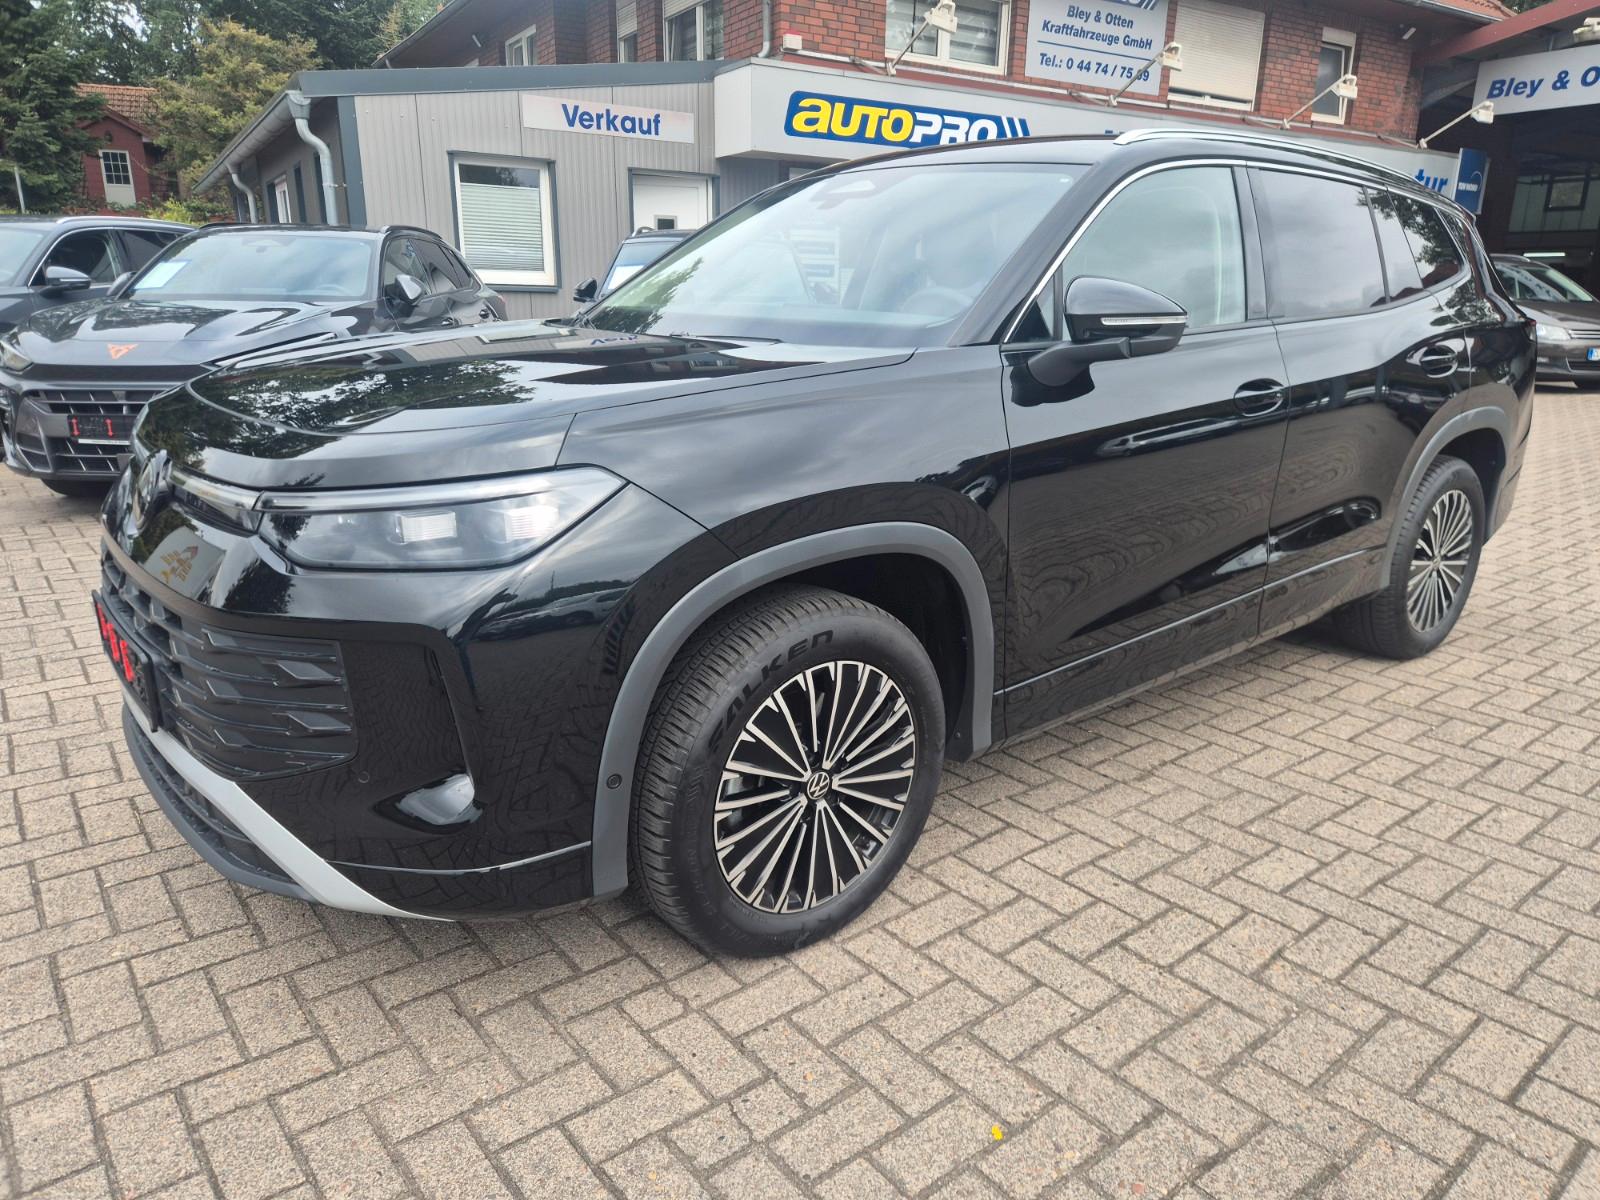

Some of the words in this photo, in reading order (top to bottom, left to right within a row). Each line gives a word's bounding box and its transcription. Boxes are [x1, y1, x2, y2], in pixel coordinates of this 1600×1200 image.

[1066, 5, 1091, 23] Bley
[1094, 10, 1102, 21] &
[1105, 12, 1134, 29] Otten
[1042, 19, 1120, 46] Kraftfahrzeuge
[1122, 34, 1153, 50] GmbH
[1040, 53, 1063, 68] Tel.:
[1066, 57, 1074, 70] 0
[1076, 60, 1092, 73] 44
[1095, 62, 1109, 76] 74
[1110, 64, 1118, 77] /
[1120, 66, 1134, 79] 75
[1486, 77, 1545, 99] Bley
[1551, 70, 1570, 91] &
[561, 103, 661, 136] Verkauf
